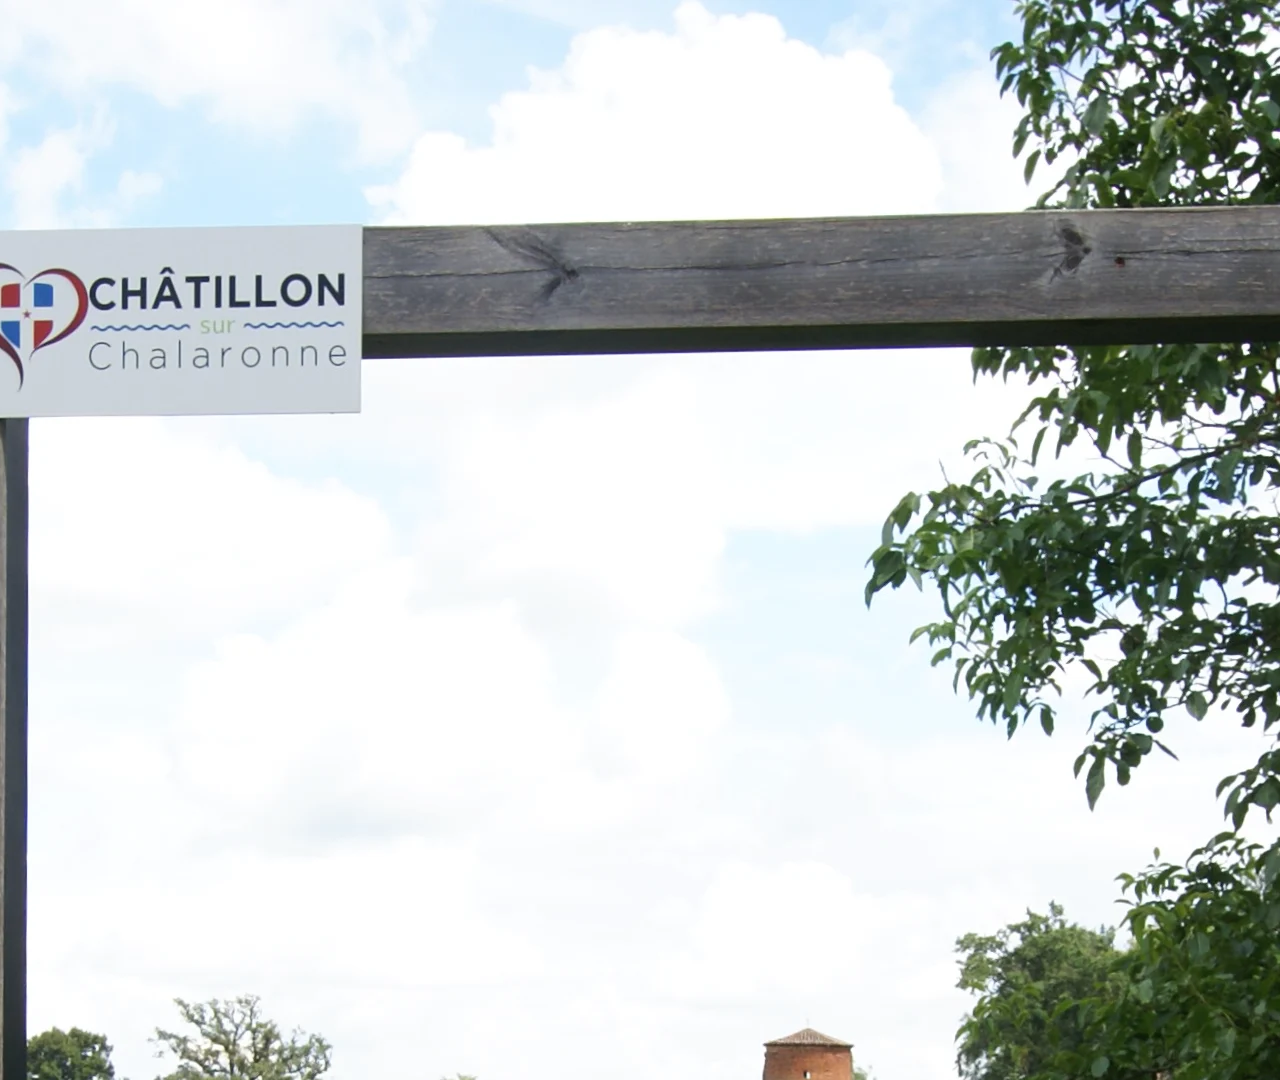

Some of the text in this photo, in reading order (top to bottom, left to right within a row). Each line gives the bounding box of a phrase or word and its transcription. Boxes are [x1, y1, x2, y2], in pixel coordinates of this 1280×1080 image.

[88, 266, 346, 311] CHÂTILLON
[200, 317, 236, 335] sur
[88, 339, 347, 371] Chalaronne
